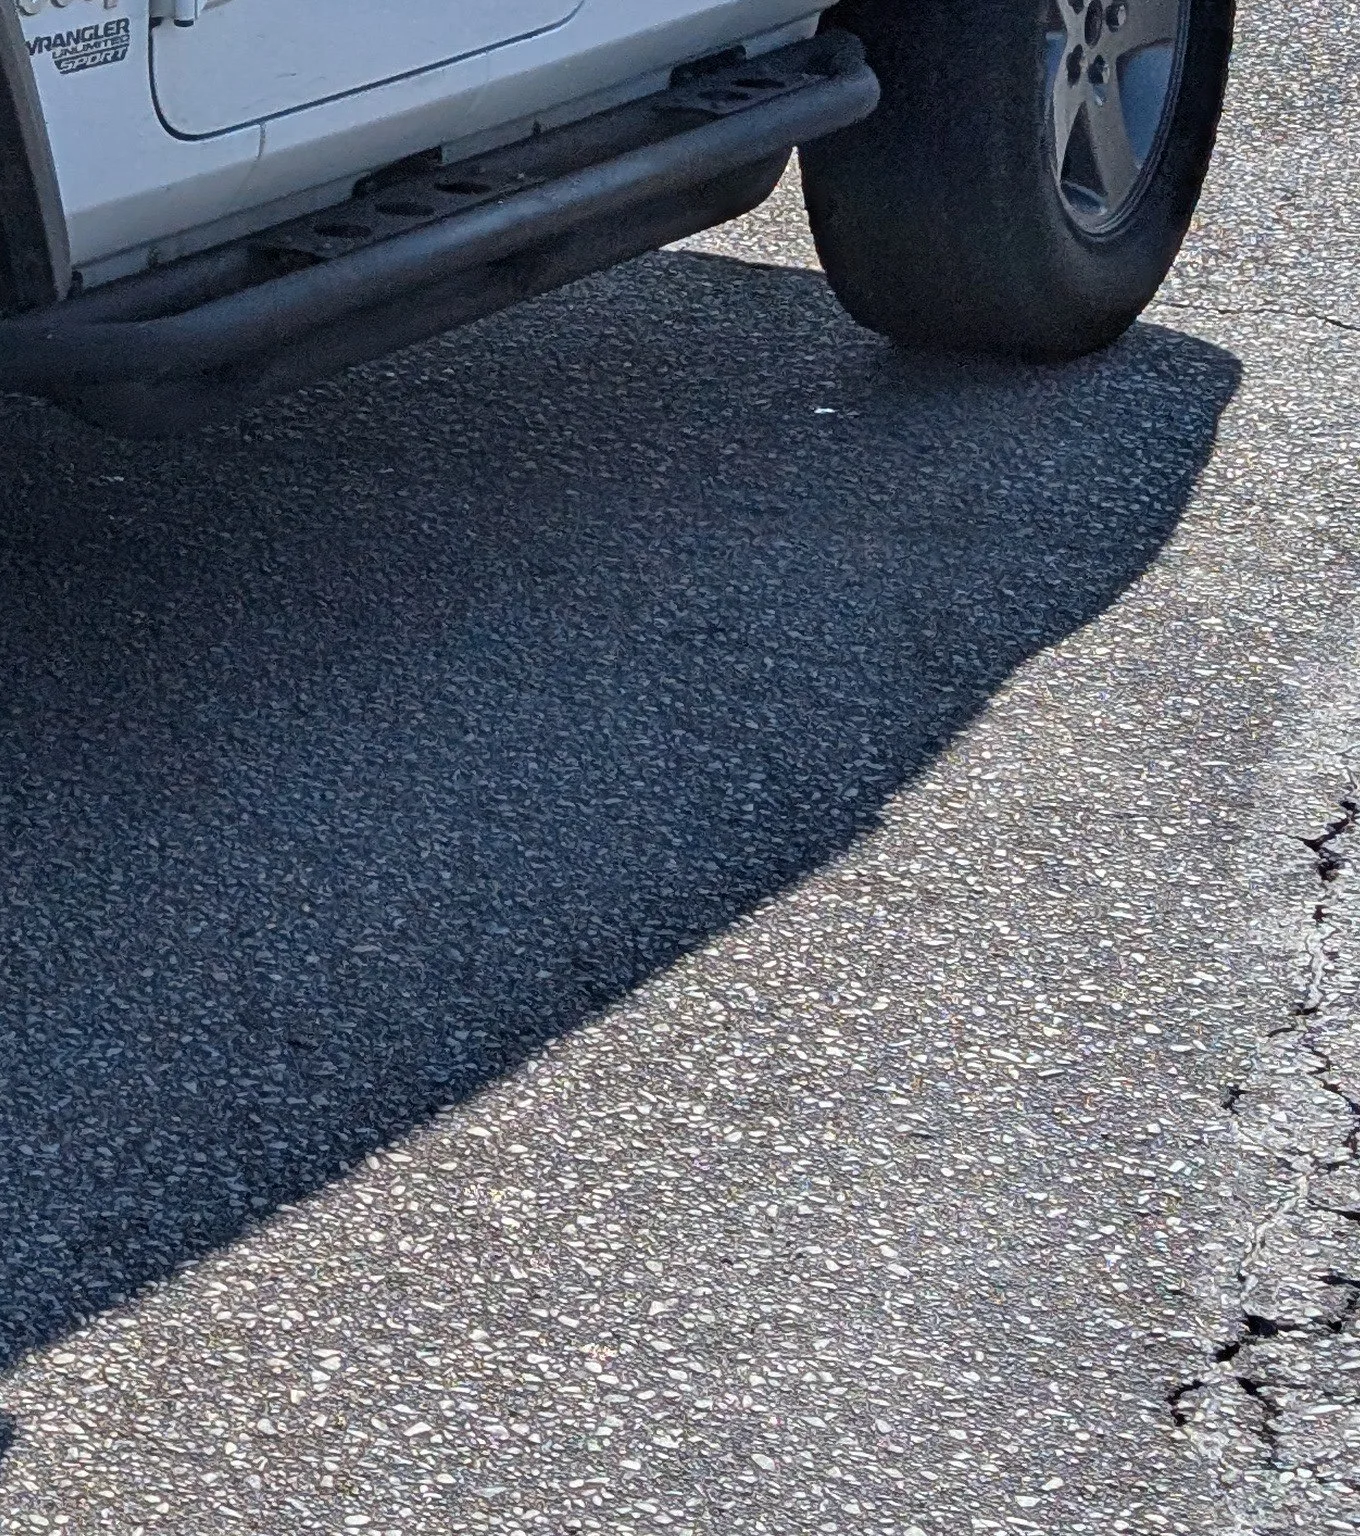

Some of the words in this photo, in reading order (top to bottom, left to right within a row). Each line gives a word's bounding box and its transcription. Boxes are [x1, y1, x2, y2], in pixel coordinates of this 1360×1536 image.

[25, 17, 130, 56] WRANGLER
[51, 34, 130, 59] UNLIMITED
[57, 47, 127, 71] SPORT
